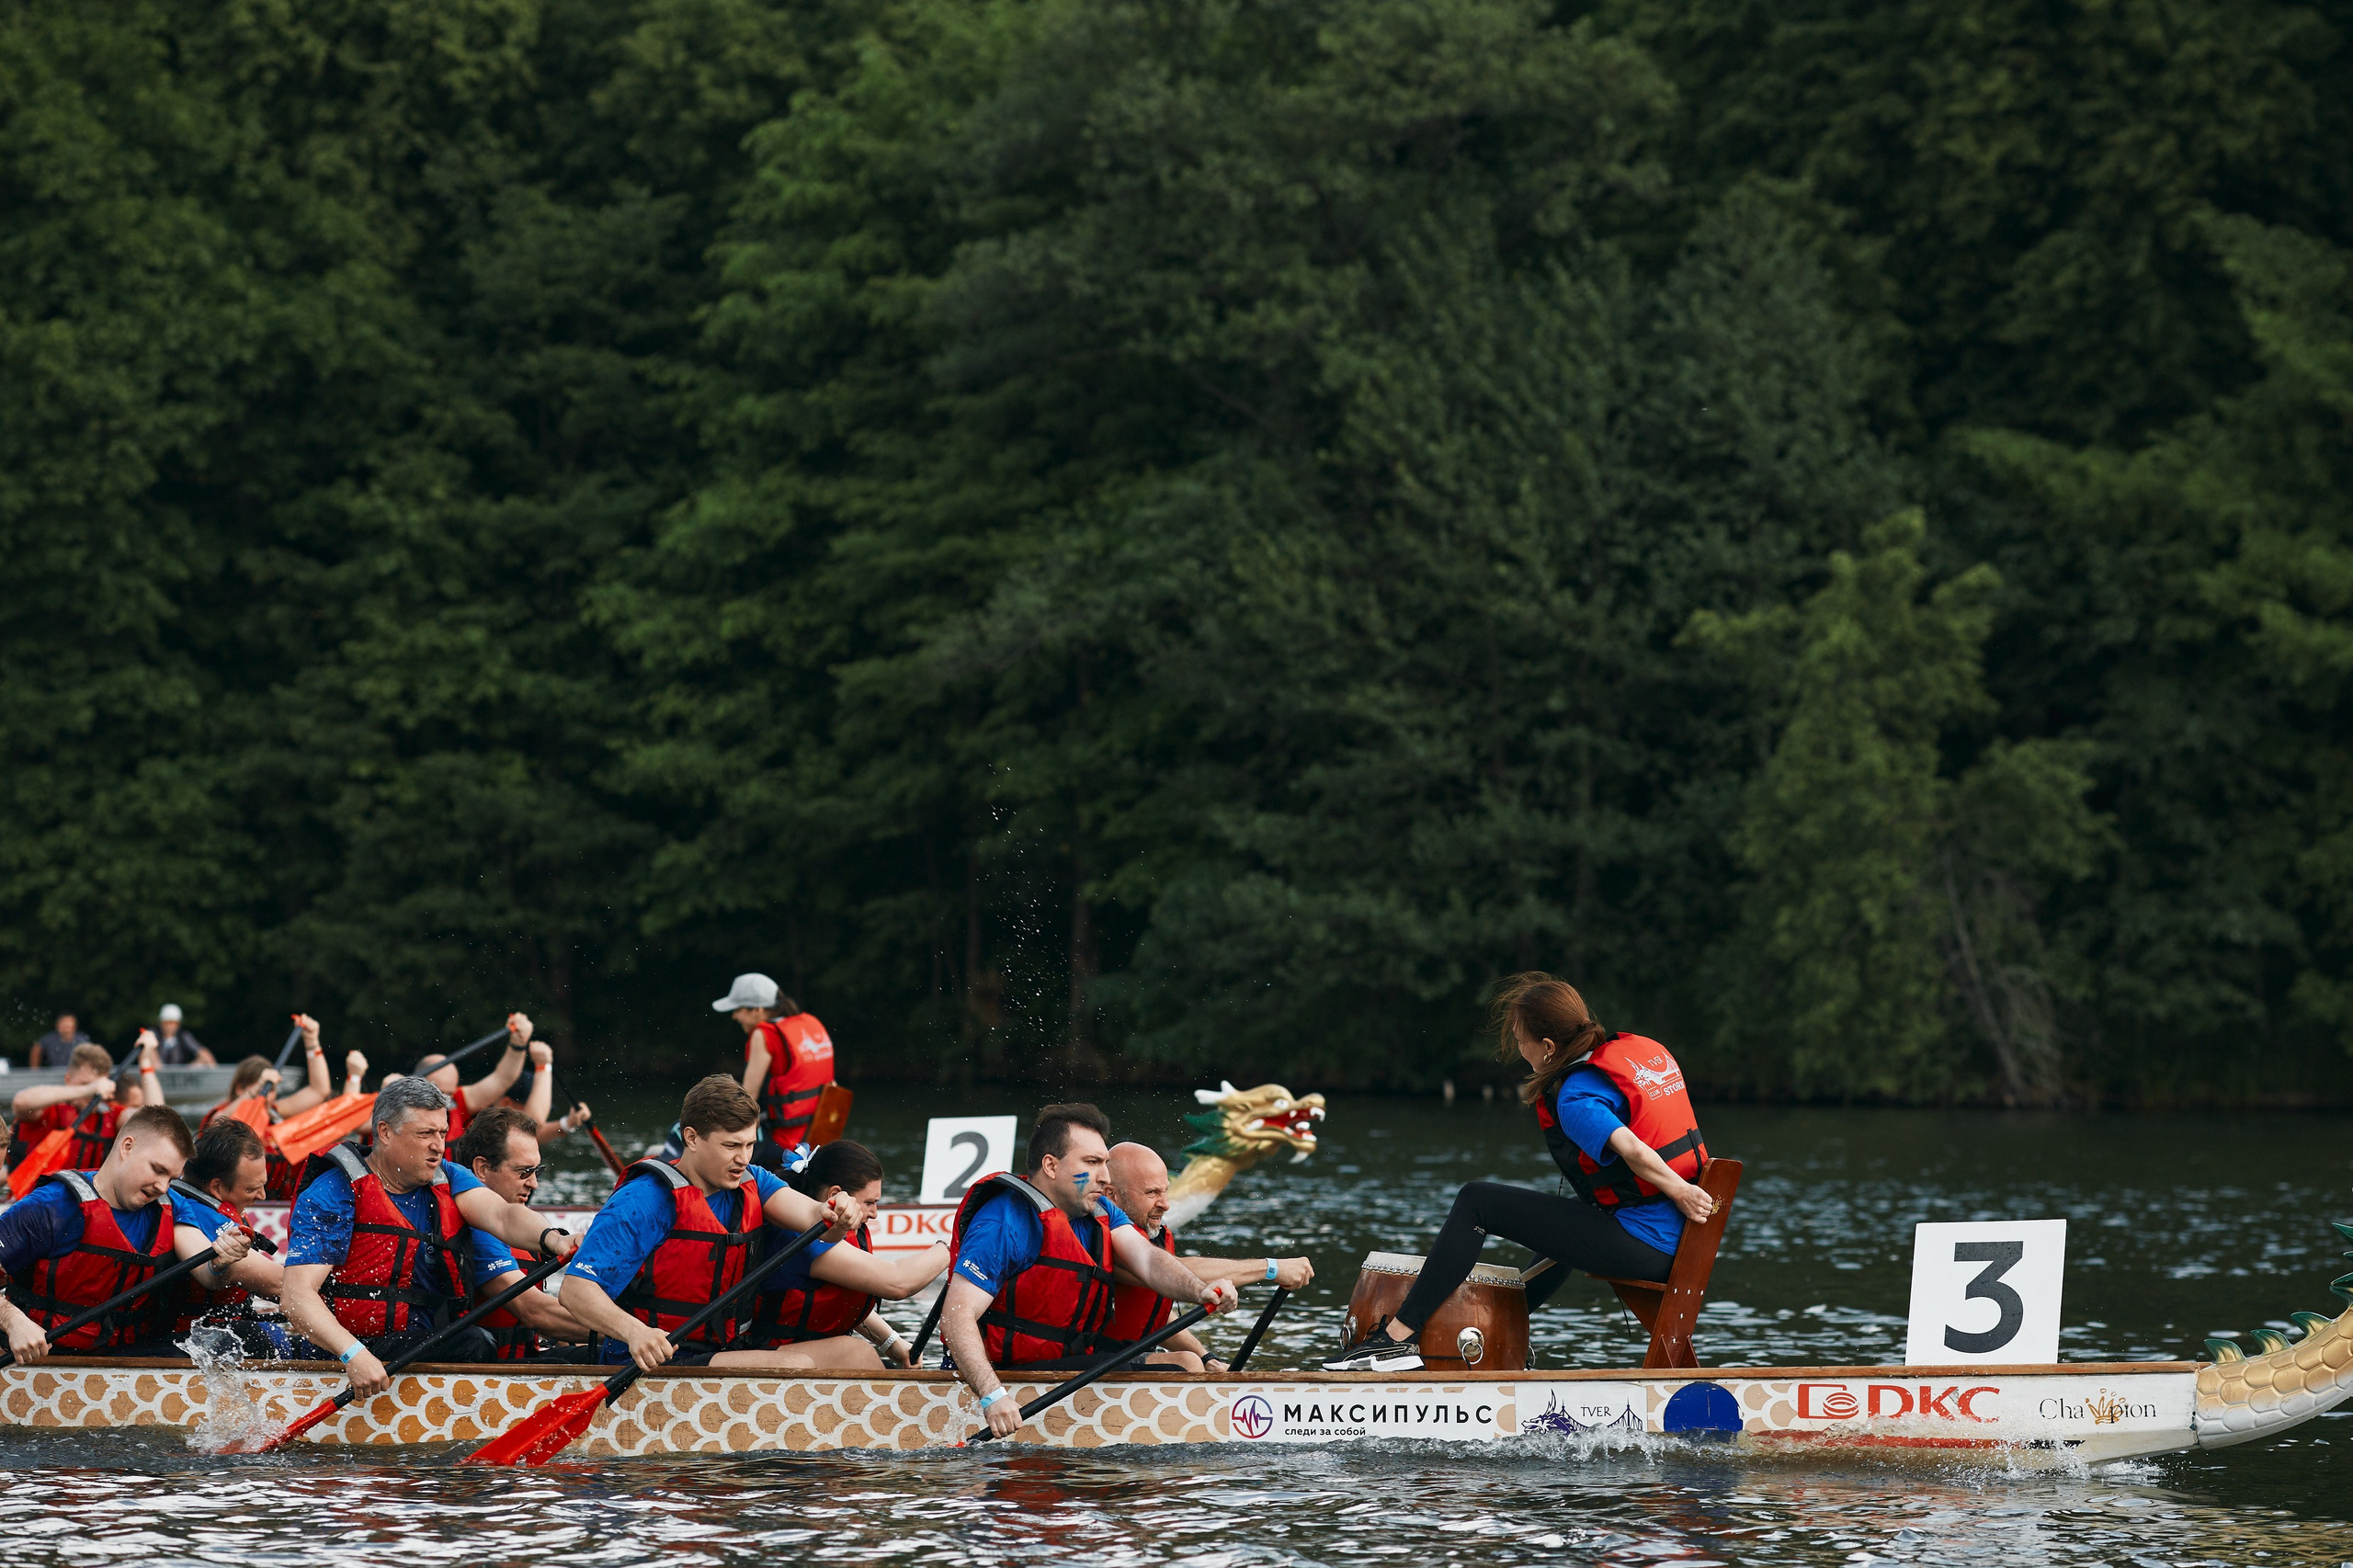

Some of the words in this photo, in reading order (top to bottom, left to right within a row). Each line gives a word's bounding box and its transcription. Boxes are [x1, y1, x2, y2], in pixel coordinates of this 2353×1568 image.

[943, 1131, 989, 1199] 2
[1944, 1241, 2024, 1354] 3
[1284, 1403, 1493, 1425] МАКСИПУЛЬС
[1580, 1405, 1612, 1417] TVER
[1868, 1384, 2001, 1424] DKC
[1284, 1428, 1317, 1437] следи
[1334, 1426, 1366, 1436] собой
